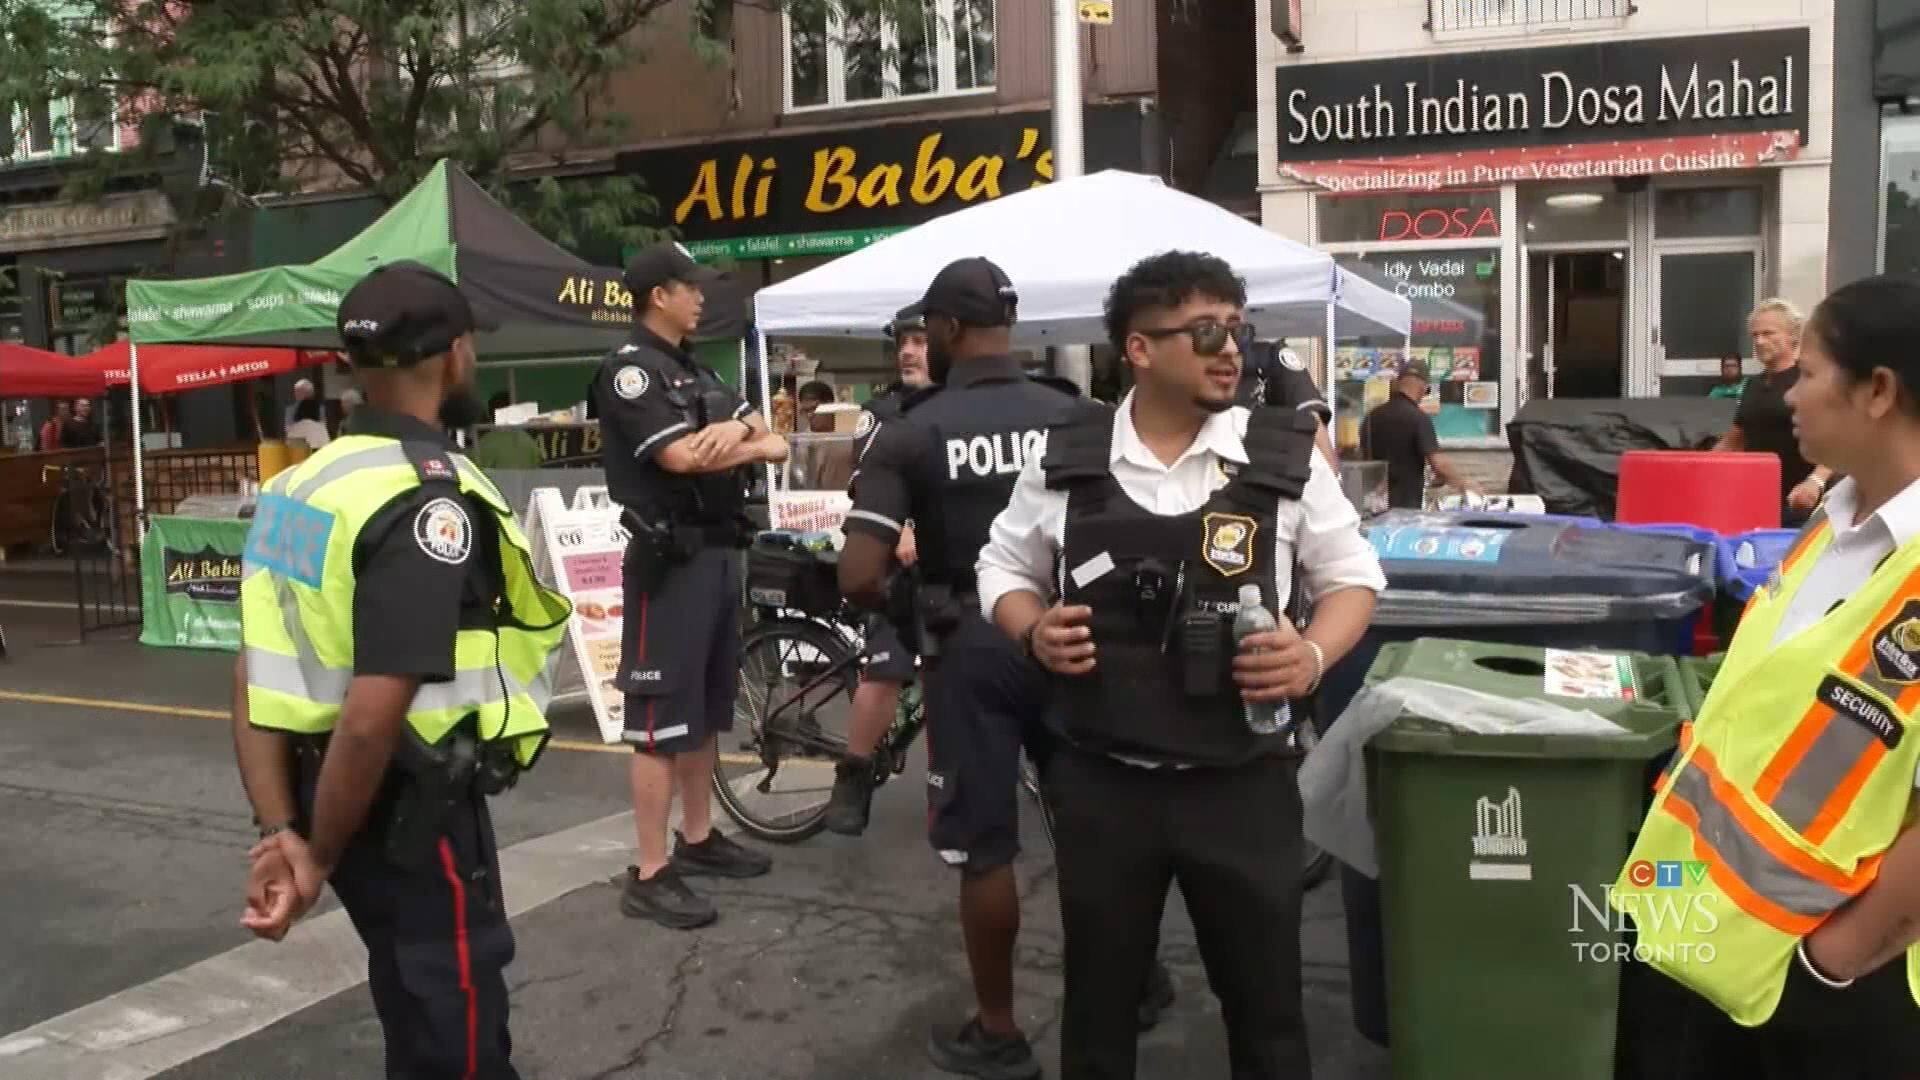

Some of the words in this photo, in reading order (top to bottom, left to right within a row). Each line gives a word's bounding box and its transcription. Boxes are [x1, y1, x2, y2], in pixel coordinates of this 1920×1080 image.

[1288, 84, 1396, 144] South
[1405, 78, 1530, 136] Indian
[1540, 71, 1644, 129] Dosa
[1656, 55, 1793, 121] Mahal
[1447, 168, 1468, 186] in
[1472, 164, 1526, 183] Pure
[1529, 154, 1653, 180] Vegetarian
[1660, 151, 1745, 172] Cuisine
[674, 153, 778, 224] Ali
[1379, 207, 1500, 241] DOSA
[1384, 260, 1413, 281] Idly
[1418, 258, 1465, 277] Vadai
[247, 293, 285, 312] soups
[558, 276, 594, 305] Ali
[1394, 281, 1456, 299] Combo
[175, 367, 217, 384] STELLA
[229, 359, 269, 376] ARTOIS
[946, 427, 1048, 480] POLIC
[168, 560, 194, 581] Ali
[631, 669, 662, 681] POLICE
[1830, 686, 1895, 736] SECURITY
